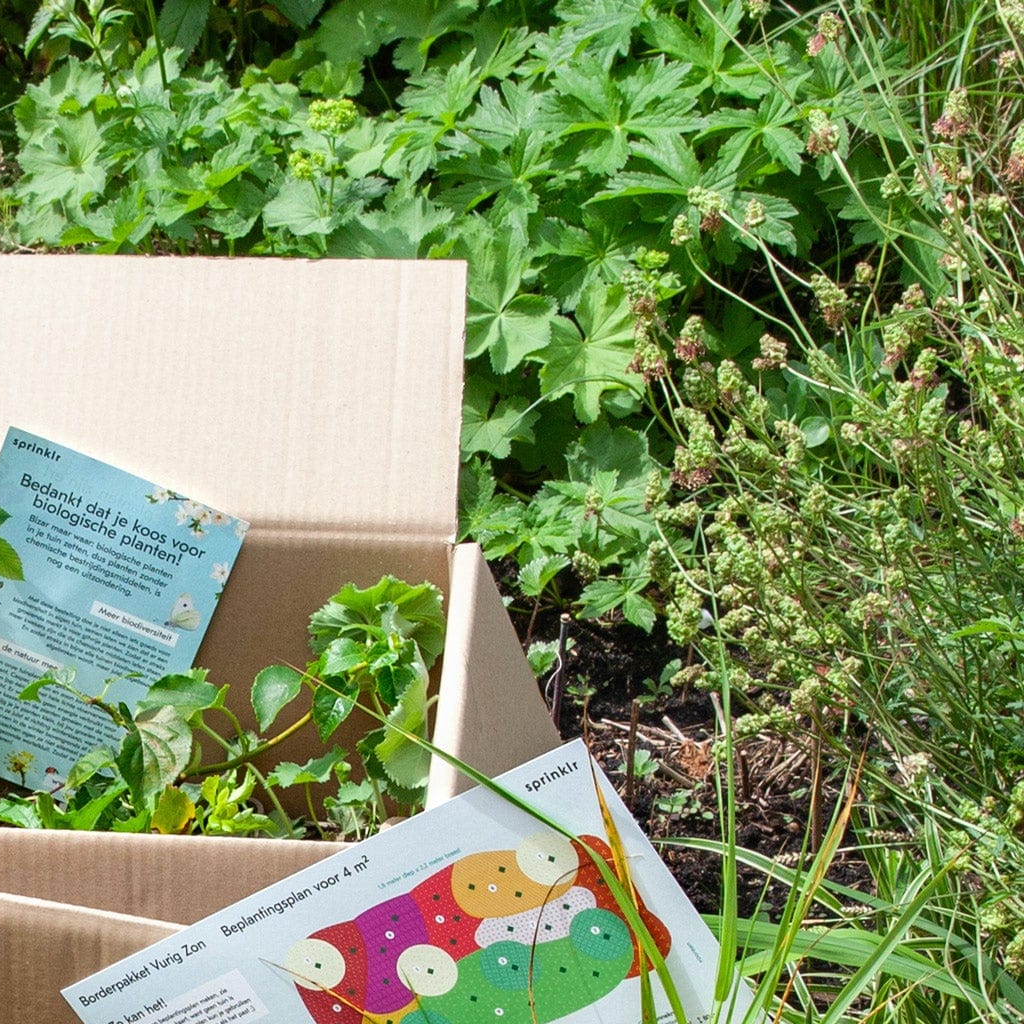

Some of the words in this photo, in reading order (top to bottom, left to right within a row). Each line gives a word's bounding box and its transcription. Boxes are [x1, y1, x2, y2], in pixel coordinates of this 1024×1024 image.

[12, 437, 61, 462] sprinklr
[19, 472, 83, 508] Bedankt
[85, 501, 111, 520] dat
[110, 510, 128, 528] je
[131, 518, 168, 544] koos
[171, 537, 206, 559] voor
[28, 513, 50, 528] Bizar
[50, 524, 72, 537] maar
[73, 533, 95, 548] waar:
[95, 541, 142, 567] biologische
[141, 562, 173, 580] planten
[32, 493, 117, 539] biologische
[119, 534, 183, 566] planten!
[24, 535, 68, 558] chemische
[68, 552, 152, 595] bestrijdingsmiddelen,
[153, 587, 161, 597] is
[25, 523, 35, 534] in
[34, 527, 45, 538] je
[45, 532, 62, 545] tuin
[62, 540, 89, 558] zetten,
[90, 552, 106, 564] dus
[106, 559, 138, 577] planten
[138, 572, 168, 588] zonder
[46, 556, 63, 569] nog
[63, 563, 80, 575] een
[81, 570, 133, 598] uitzondering.
[1, 643, 13, 654] de
[13, 649, 40, 664] natuur
[97, 606, 120, 620] Meer
[120, 615, 172, 642] biodiversiteit
[524, 761, 578, 792] sprinklr
[219, 888, 313, 937] Beplantingsplan
[312, 873, 340, 892] voor
[343, 866, 352, 877] 4
[353, 854, 370, 873] m²
[78, 965, 151, 1007] Borderpakket
[148, 952, 184, 971] Vurig
[180, 940, 207, 957] Zon
[122, 1010, 146, 1024] kan
[143, 997, 168, 1015] het!
